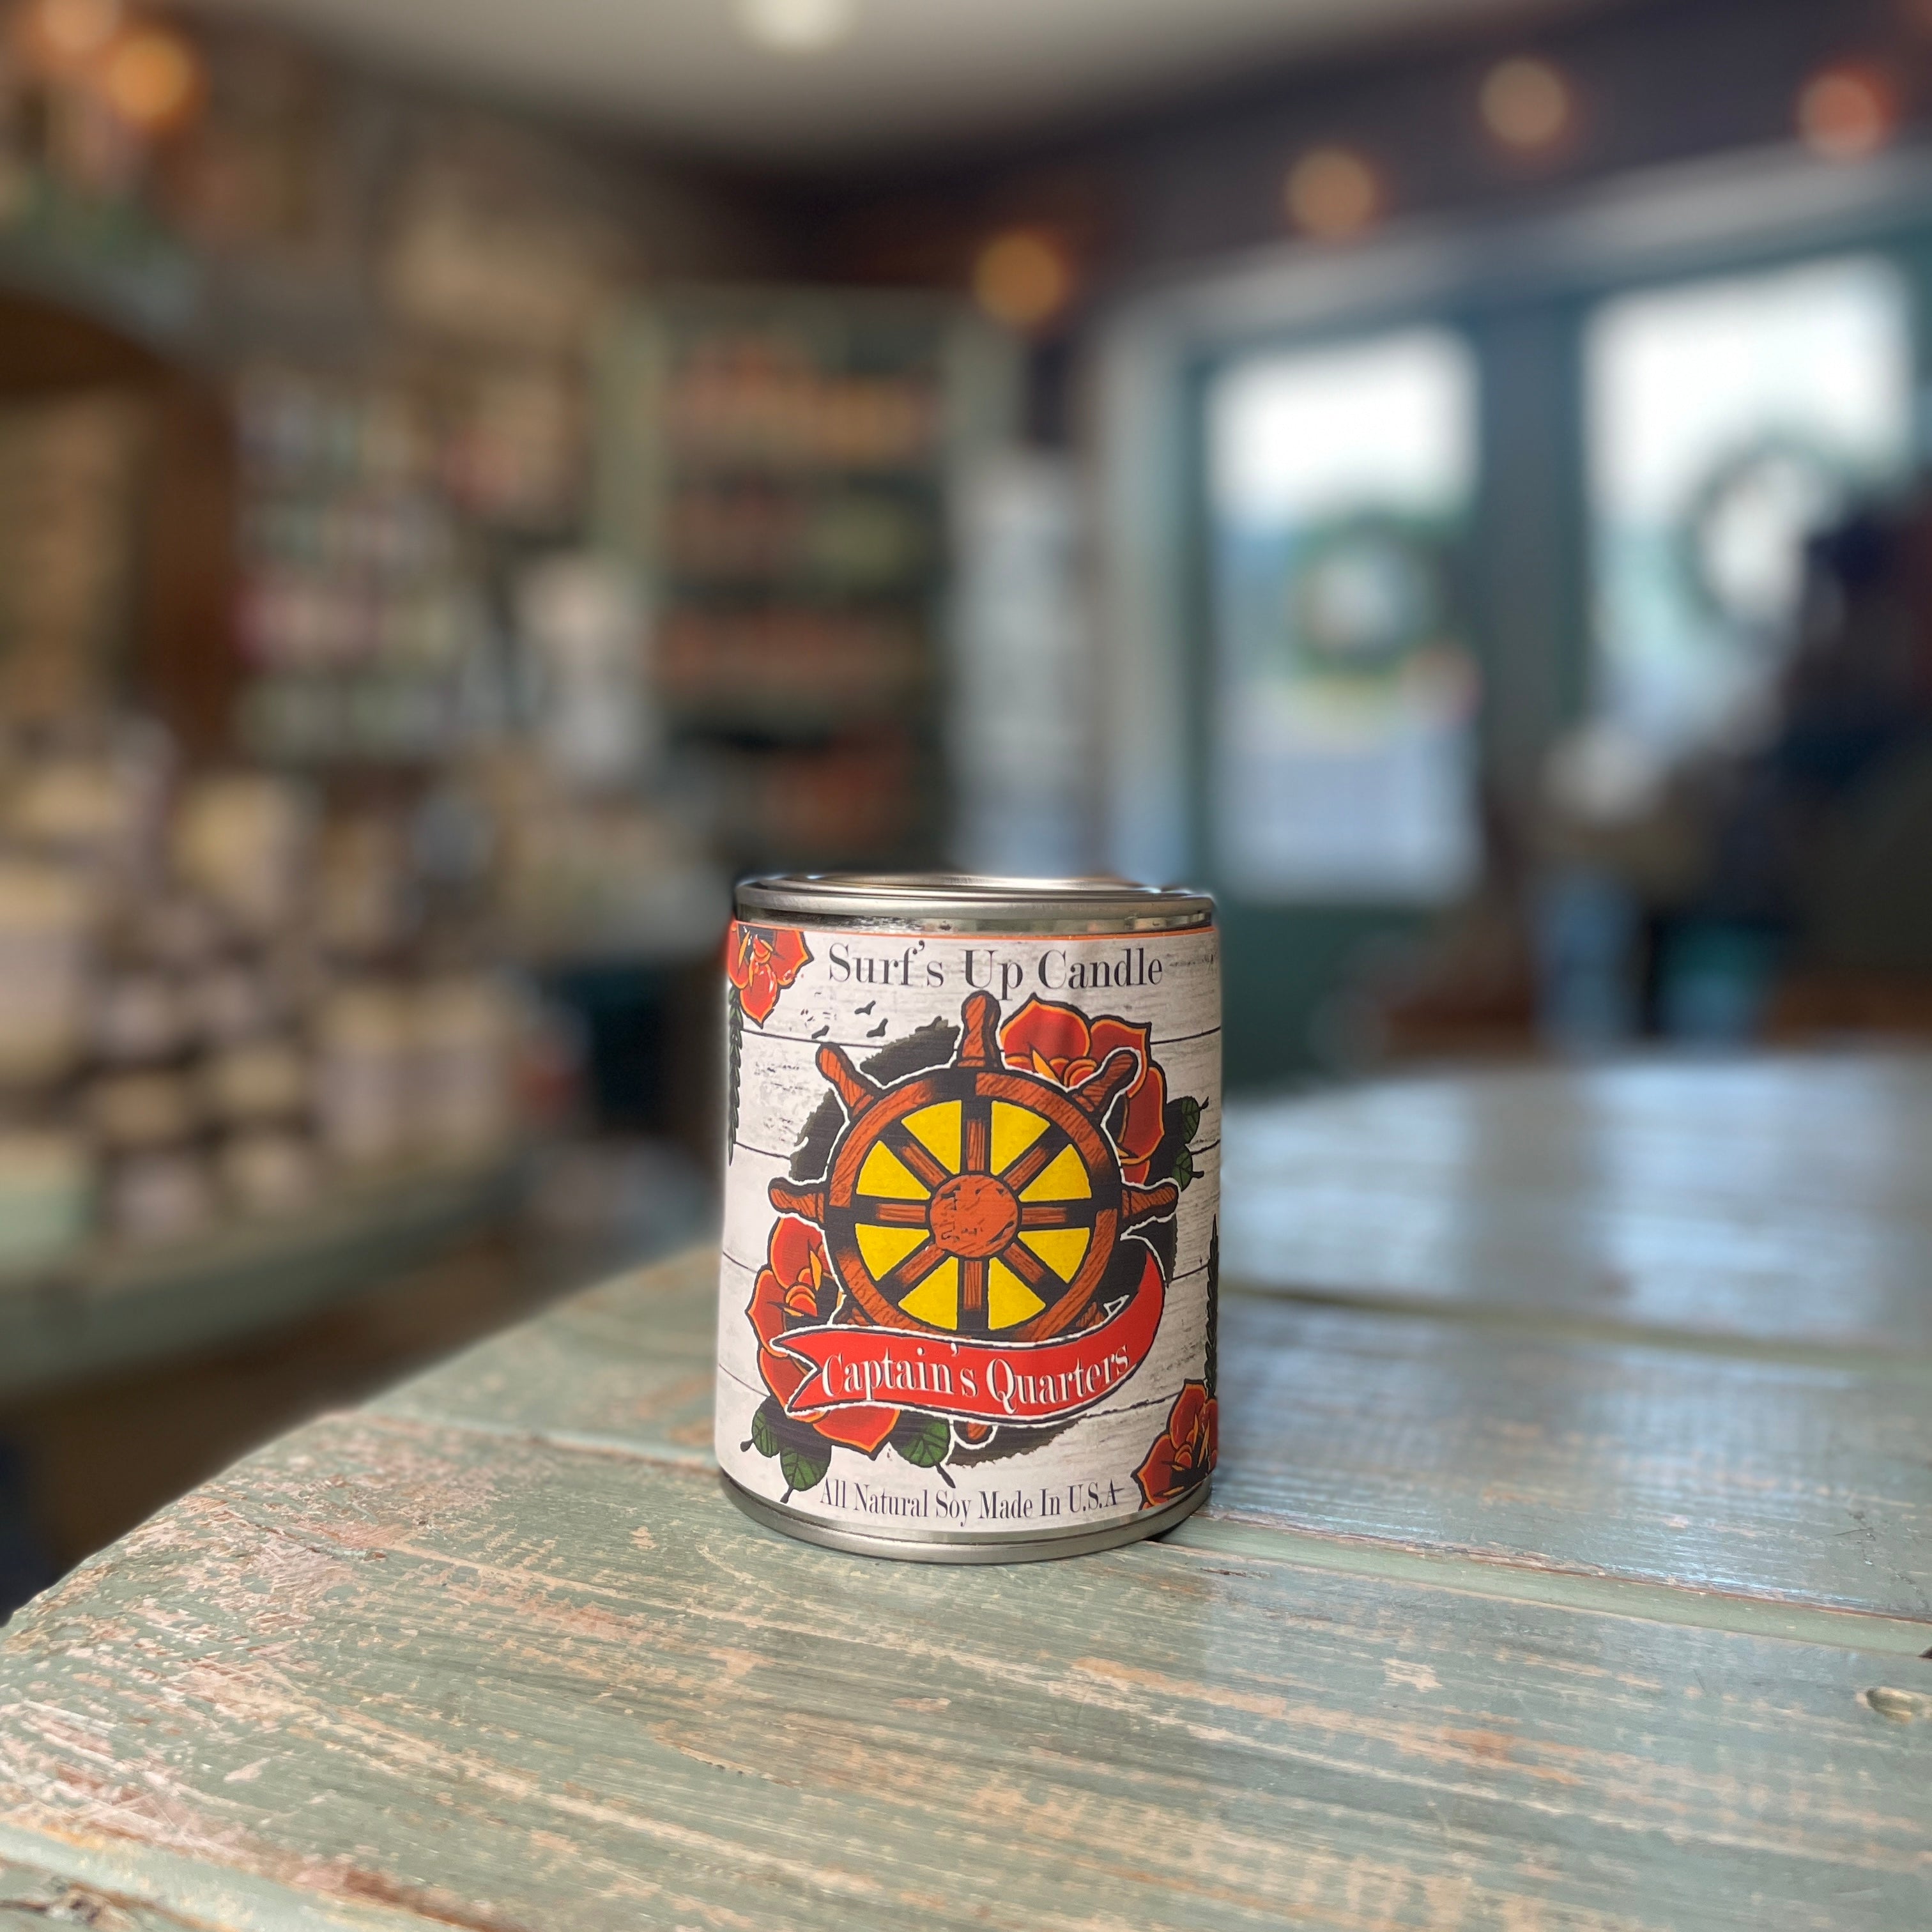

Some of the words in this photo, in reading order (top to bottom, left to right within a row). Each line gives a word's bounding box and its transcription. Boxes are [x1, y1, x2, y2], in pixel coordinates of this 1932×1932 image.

[829, 940, 943, 988] Surf's
[963, 949, 1023, 1000] Up
[1038, 948, 1163, 990] Candle
[822, 1343, 979, 1401] Captain's
[986, 1344, 1130, 1413] Quarters
[820, 1478, 846, 1508] All
[854, 1483, 929, 1517] Natural
[935, 1491, 970, 1527] Soy
[979, 1489, 1033, 1519] Made
[1040, 1487, 1061, 1516] In
[1068, 1478, 1117, 1513] U.S.A
